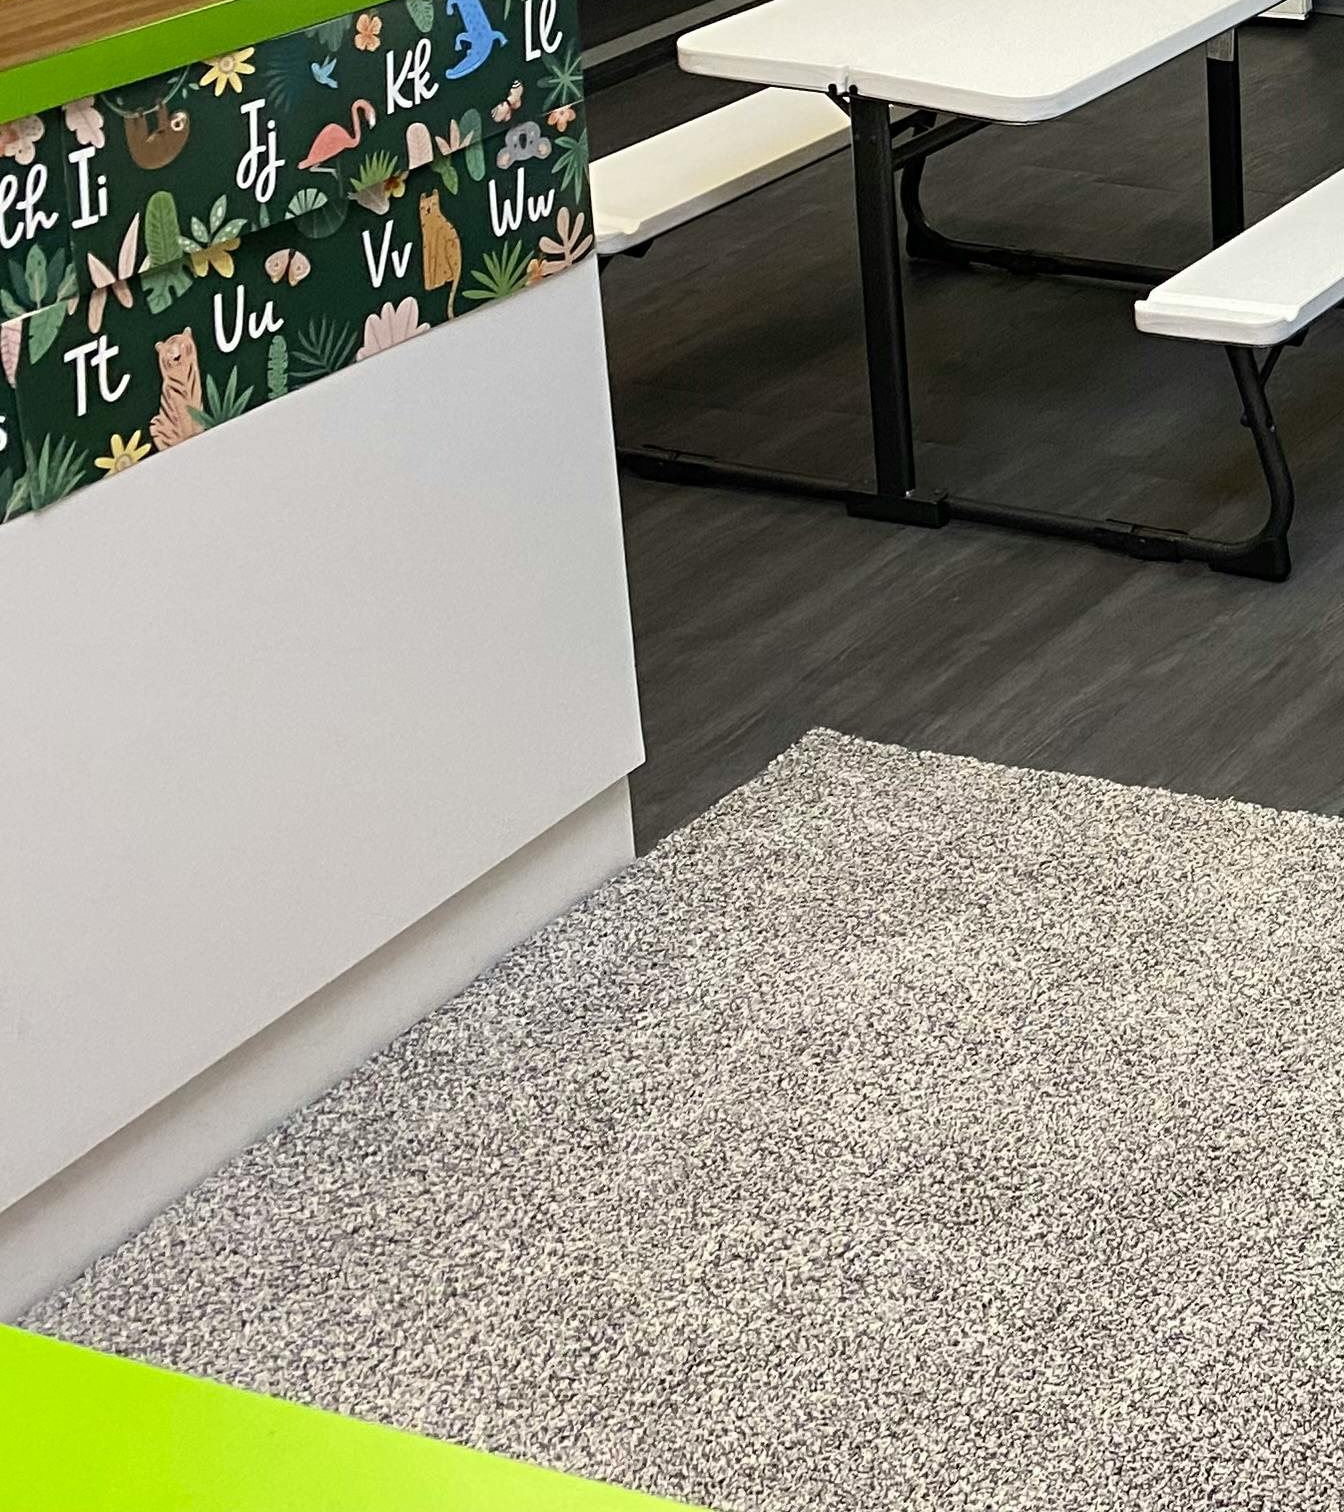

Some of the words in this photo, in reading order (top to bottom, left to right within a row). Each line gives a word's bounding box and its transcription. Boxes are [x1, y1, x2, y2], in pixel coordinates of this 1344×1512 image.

[68, 146, 108, 229] Ii
[236, 99, 286, 203] Jj
[386, 38, 439, 115] Kk
[63, 335, 131, 417] Tt
[214, 284, 284, 353] Uu
[362, 219, 413, 288] Vv
[488, 167, 555, 237] Ww
